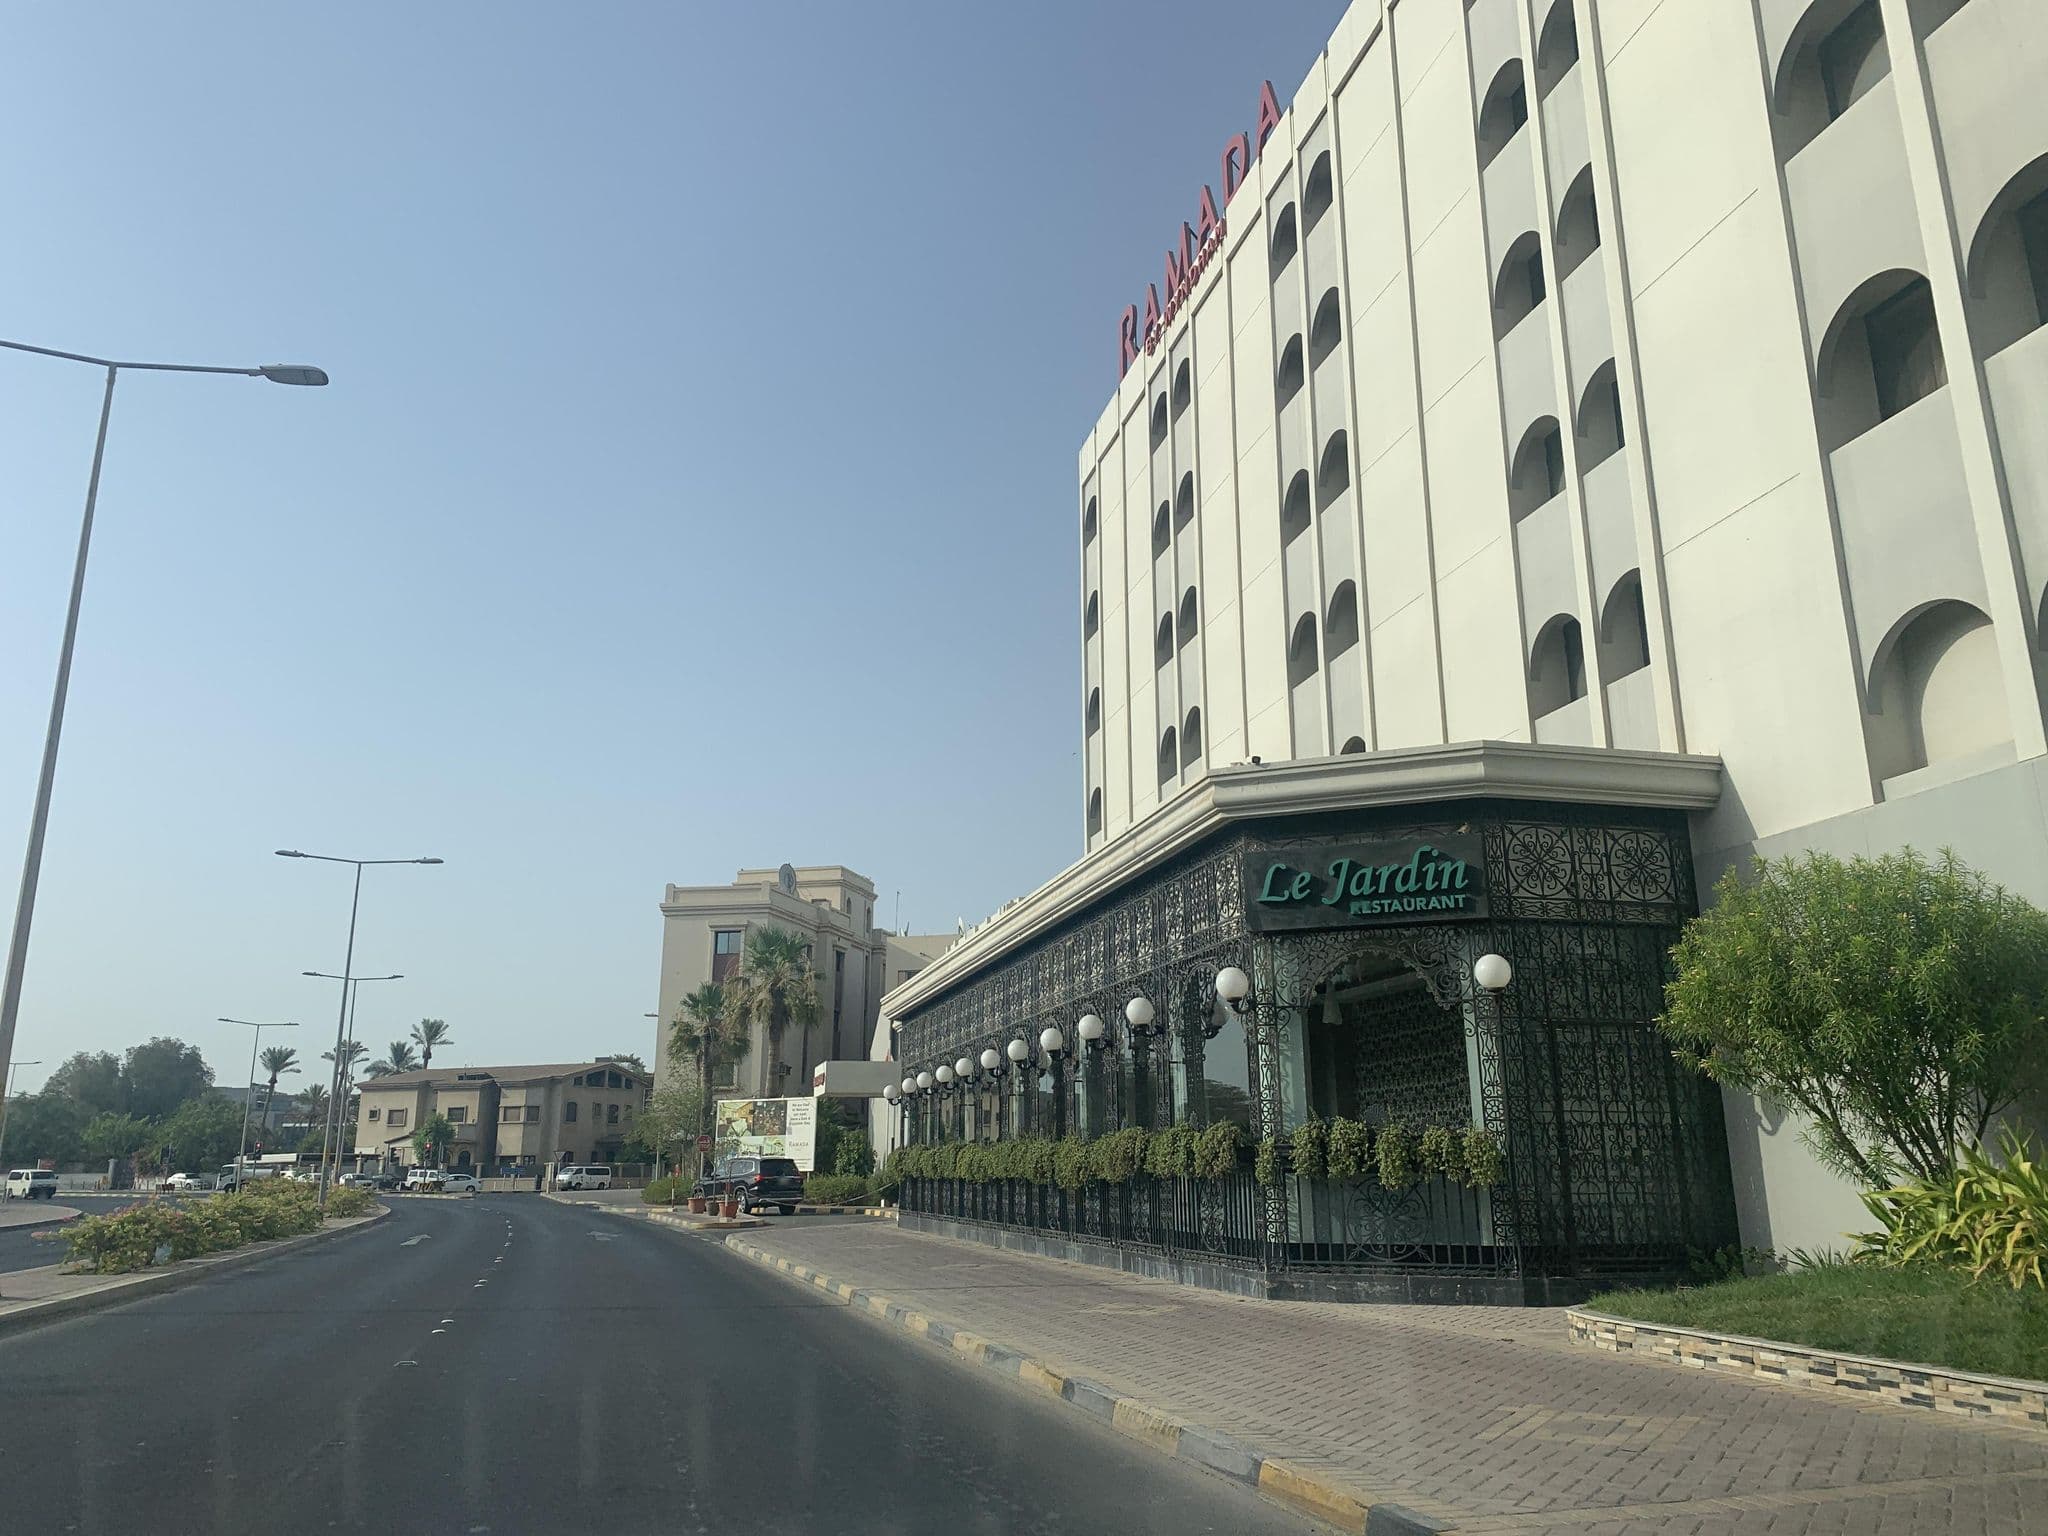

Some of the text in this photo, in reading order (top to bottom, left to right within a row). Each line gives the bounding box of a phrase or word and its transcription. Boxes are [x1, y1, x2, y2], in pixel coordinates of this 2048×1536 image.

[1120, 80, 1282, 383] RAMADA
[1257, 844, 1468, 905] Le Jardin
[1350, 894, 1466, 914] RESTAURANT
